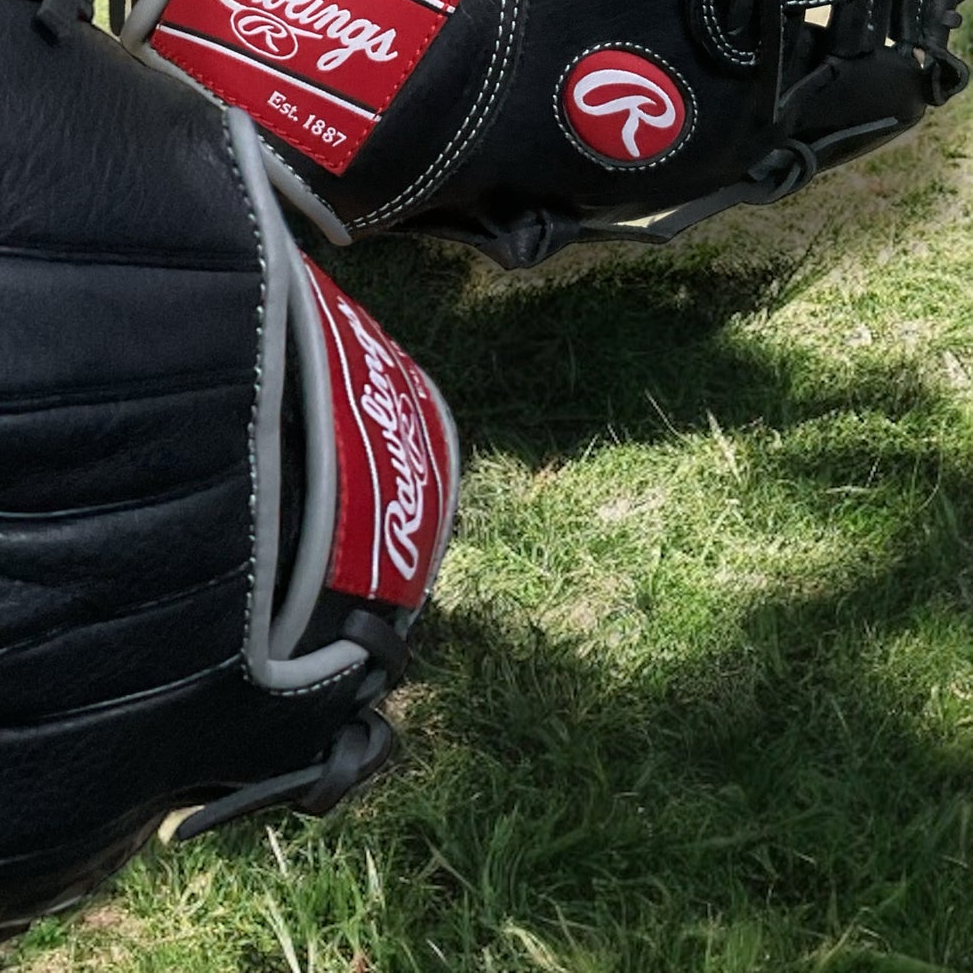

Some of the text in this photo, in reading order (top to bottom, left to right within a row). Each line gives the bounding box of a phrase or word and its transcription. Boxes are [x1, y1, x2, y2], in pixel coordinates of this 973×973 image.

[267, 90, 347, 148] Est. 1887
[573, 69, 676, 157] R
[337, 295, 425, 580] Rawlings
